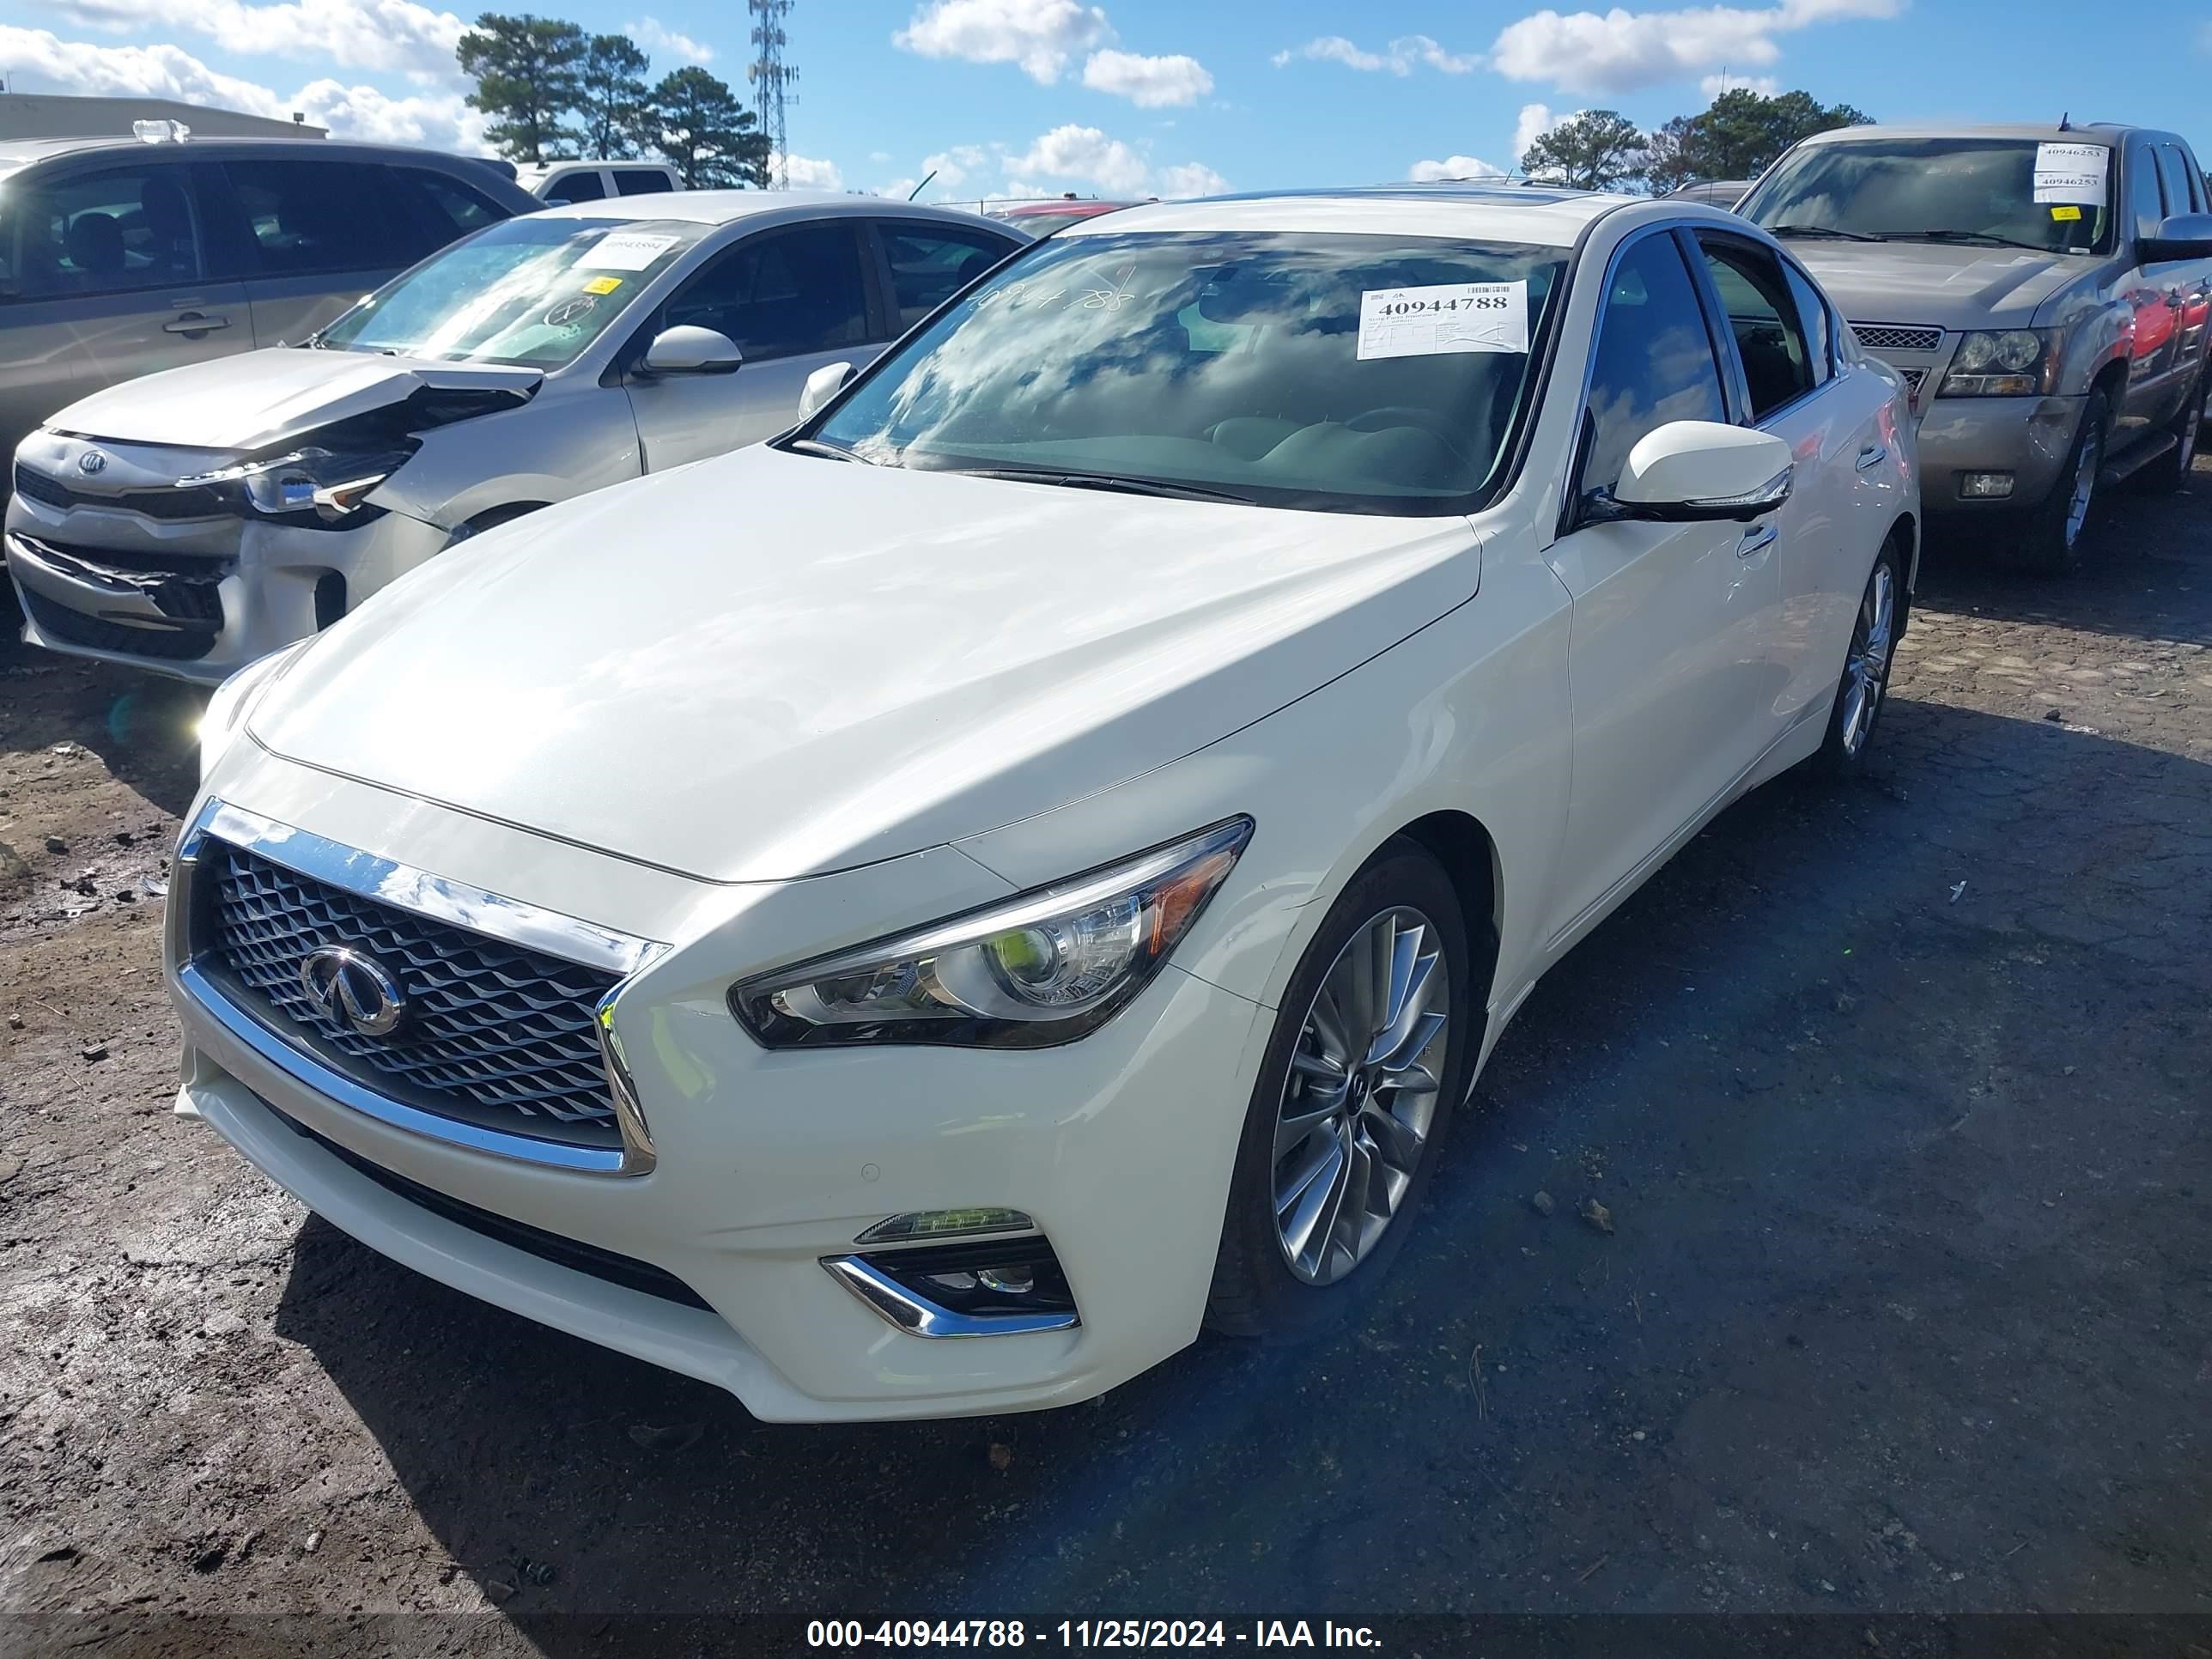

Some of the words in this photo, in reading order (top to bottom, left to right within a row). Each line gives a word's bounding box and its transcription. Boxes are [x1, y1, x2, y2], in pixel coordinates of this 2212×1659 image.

[2046, 149, 2100, 157] 40946253
[2042, 178, 2098, 186] 40946253
[1378, 296, 1508, 316] 40944788
